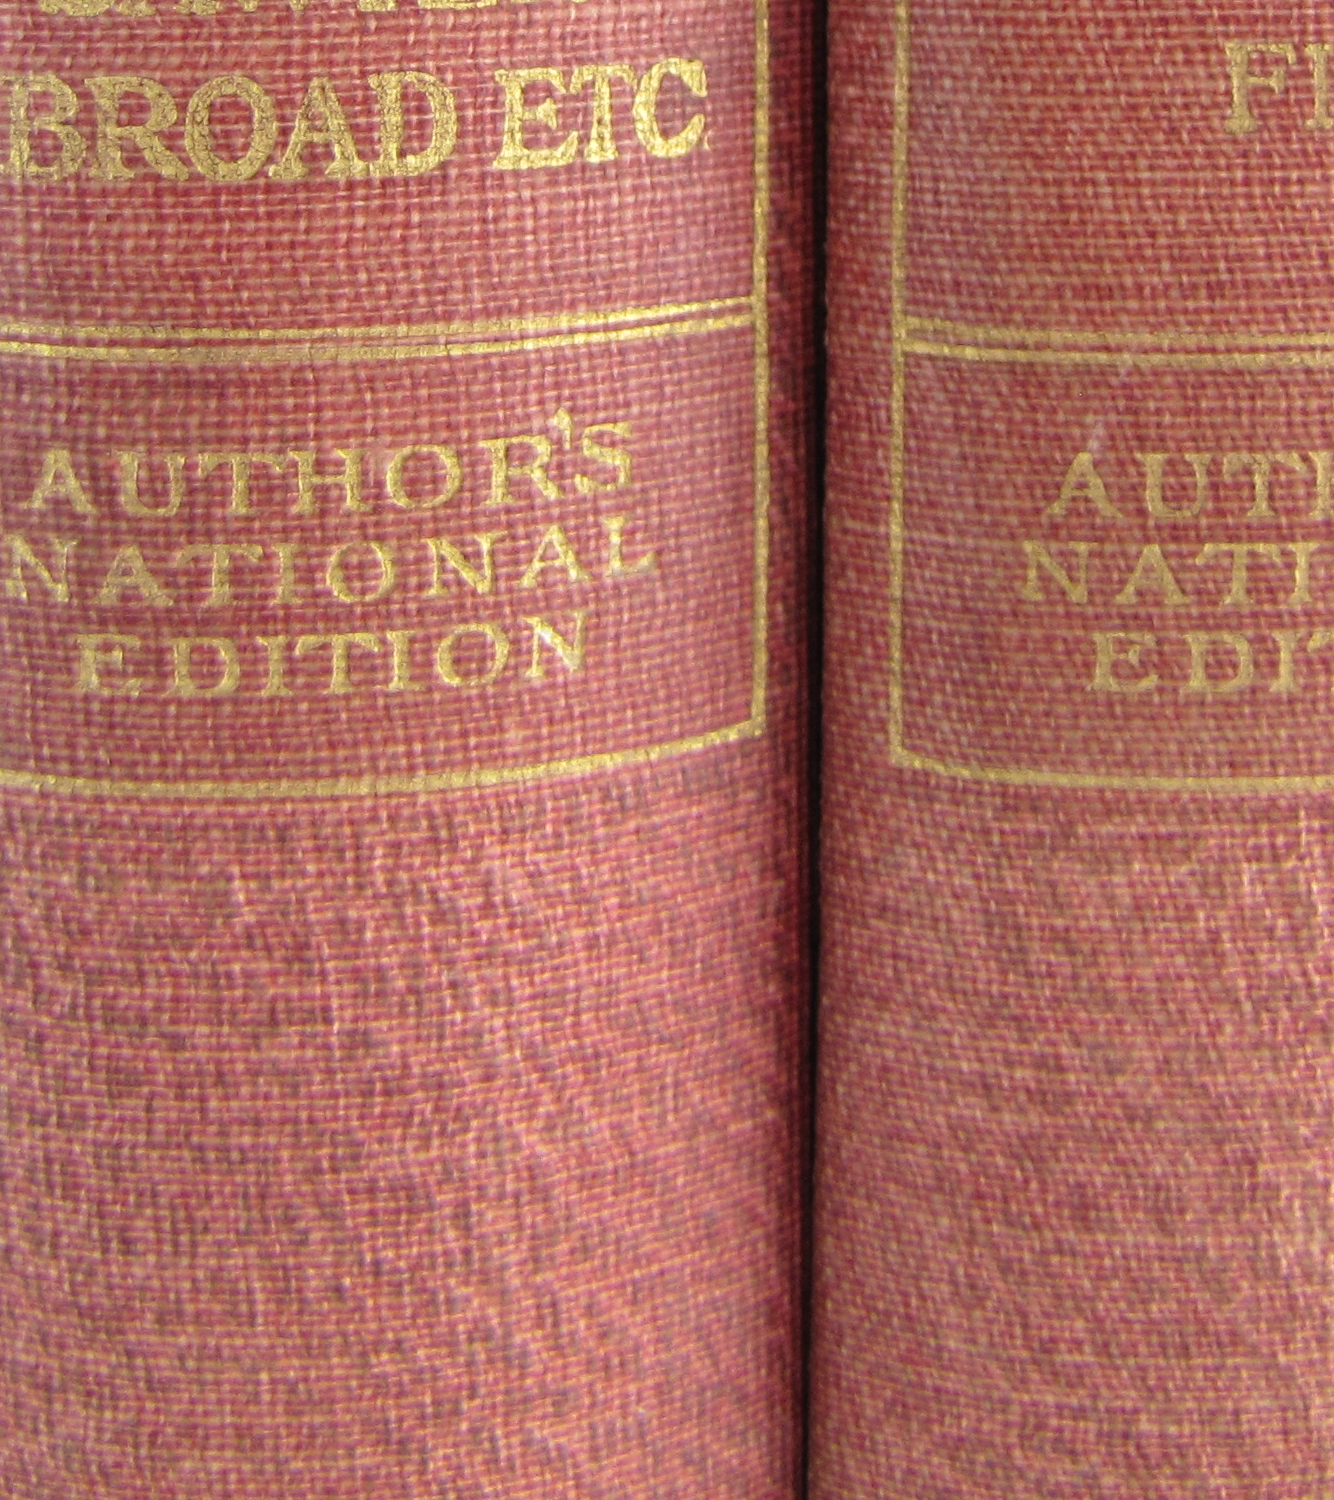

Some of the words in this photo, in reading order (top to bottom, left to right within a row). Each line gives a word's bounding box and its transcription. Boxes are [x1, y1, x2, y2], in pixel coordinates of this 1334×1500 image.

[492, 58, 709, 171] ETC
[26, 408, 633, 517] AUTHOR'S
[4, 517, 658, 609] NATIONAL
[76, 609, 588, 698] EDITION
